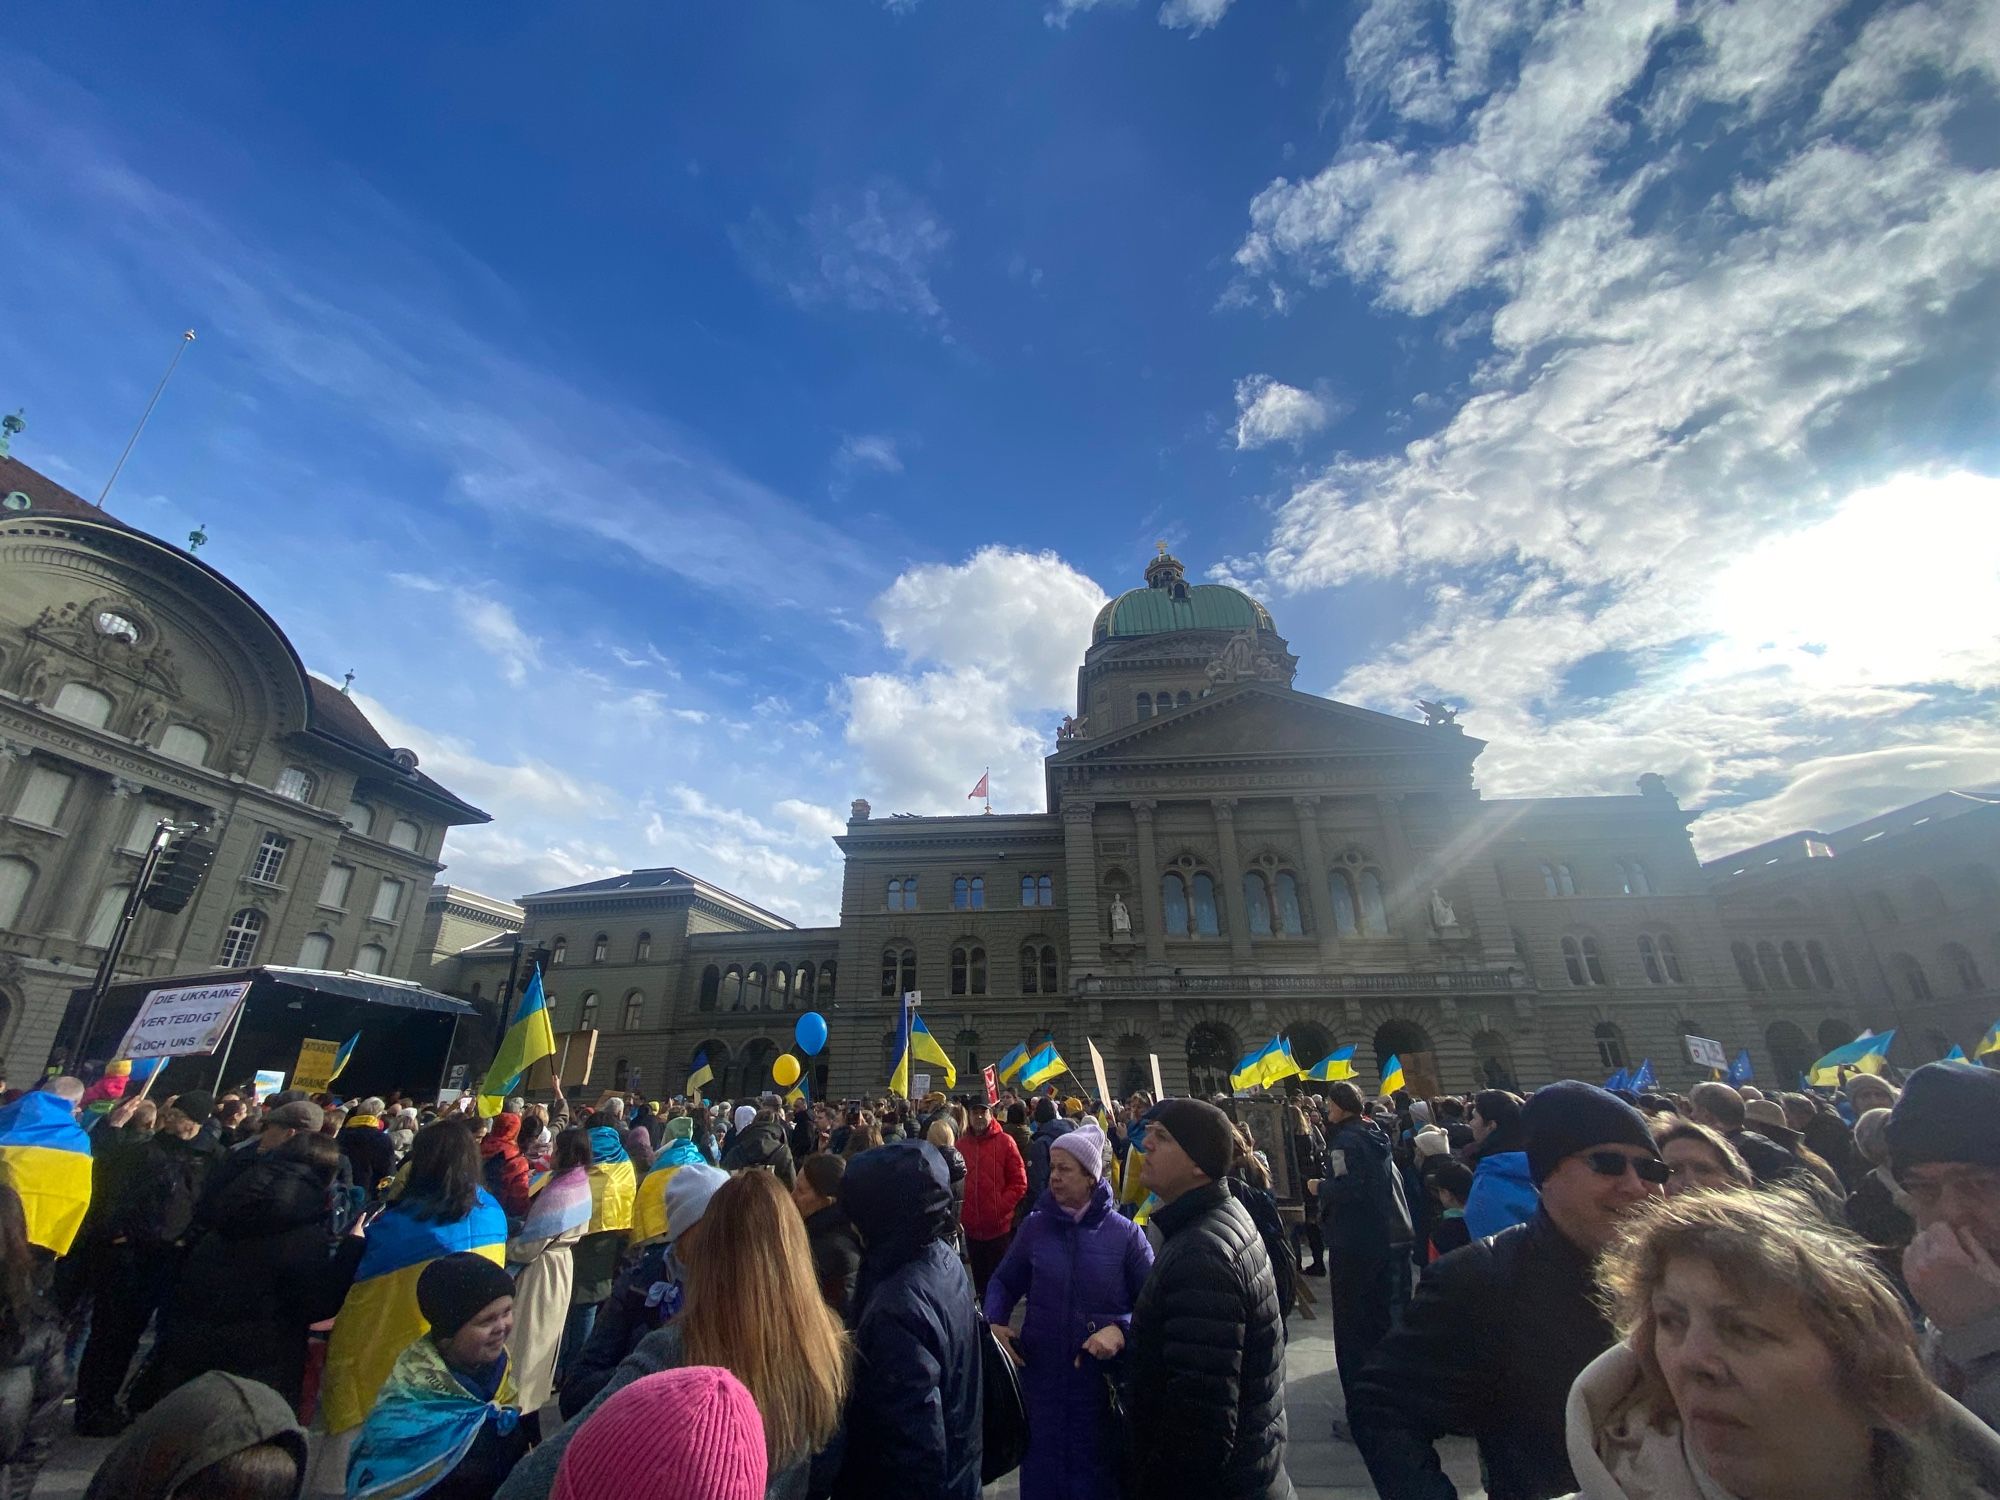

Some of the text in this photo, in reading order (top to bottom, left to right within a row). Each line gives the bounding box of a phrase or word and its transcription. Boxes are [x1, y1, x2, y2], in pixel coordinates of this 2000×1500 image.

[0, 714, 199, 792] ZERISCHE NATIONALBANK
[154, 988, 241, 1006] DIE UKRAINE
[135, 1040, 166, 1051] AUCH
